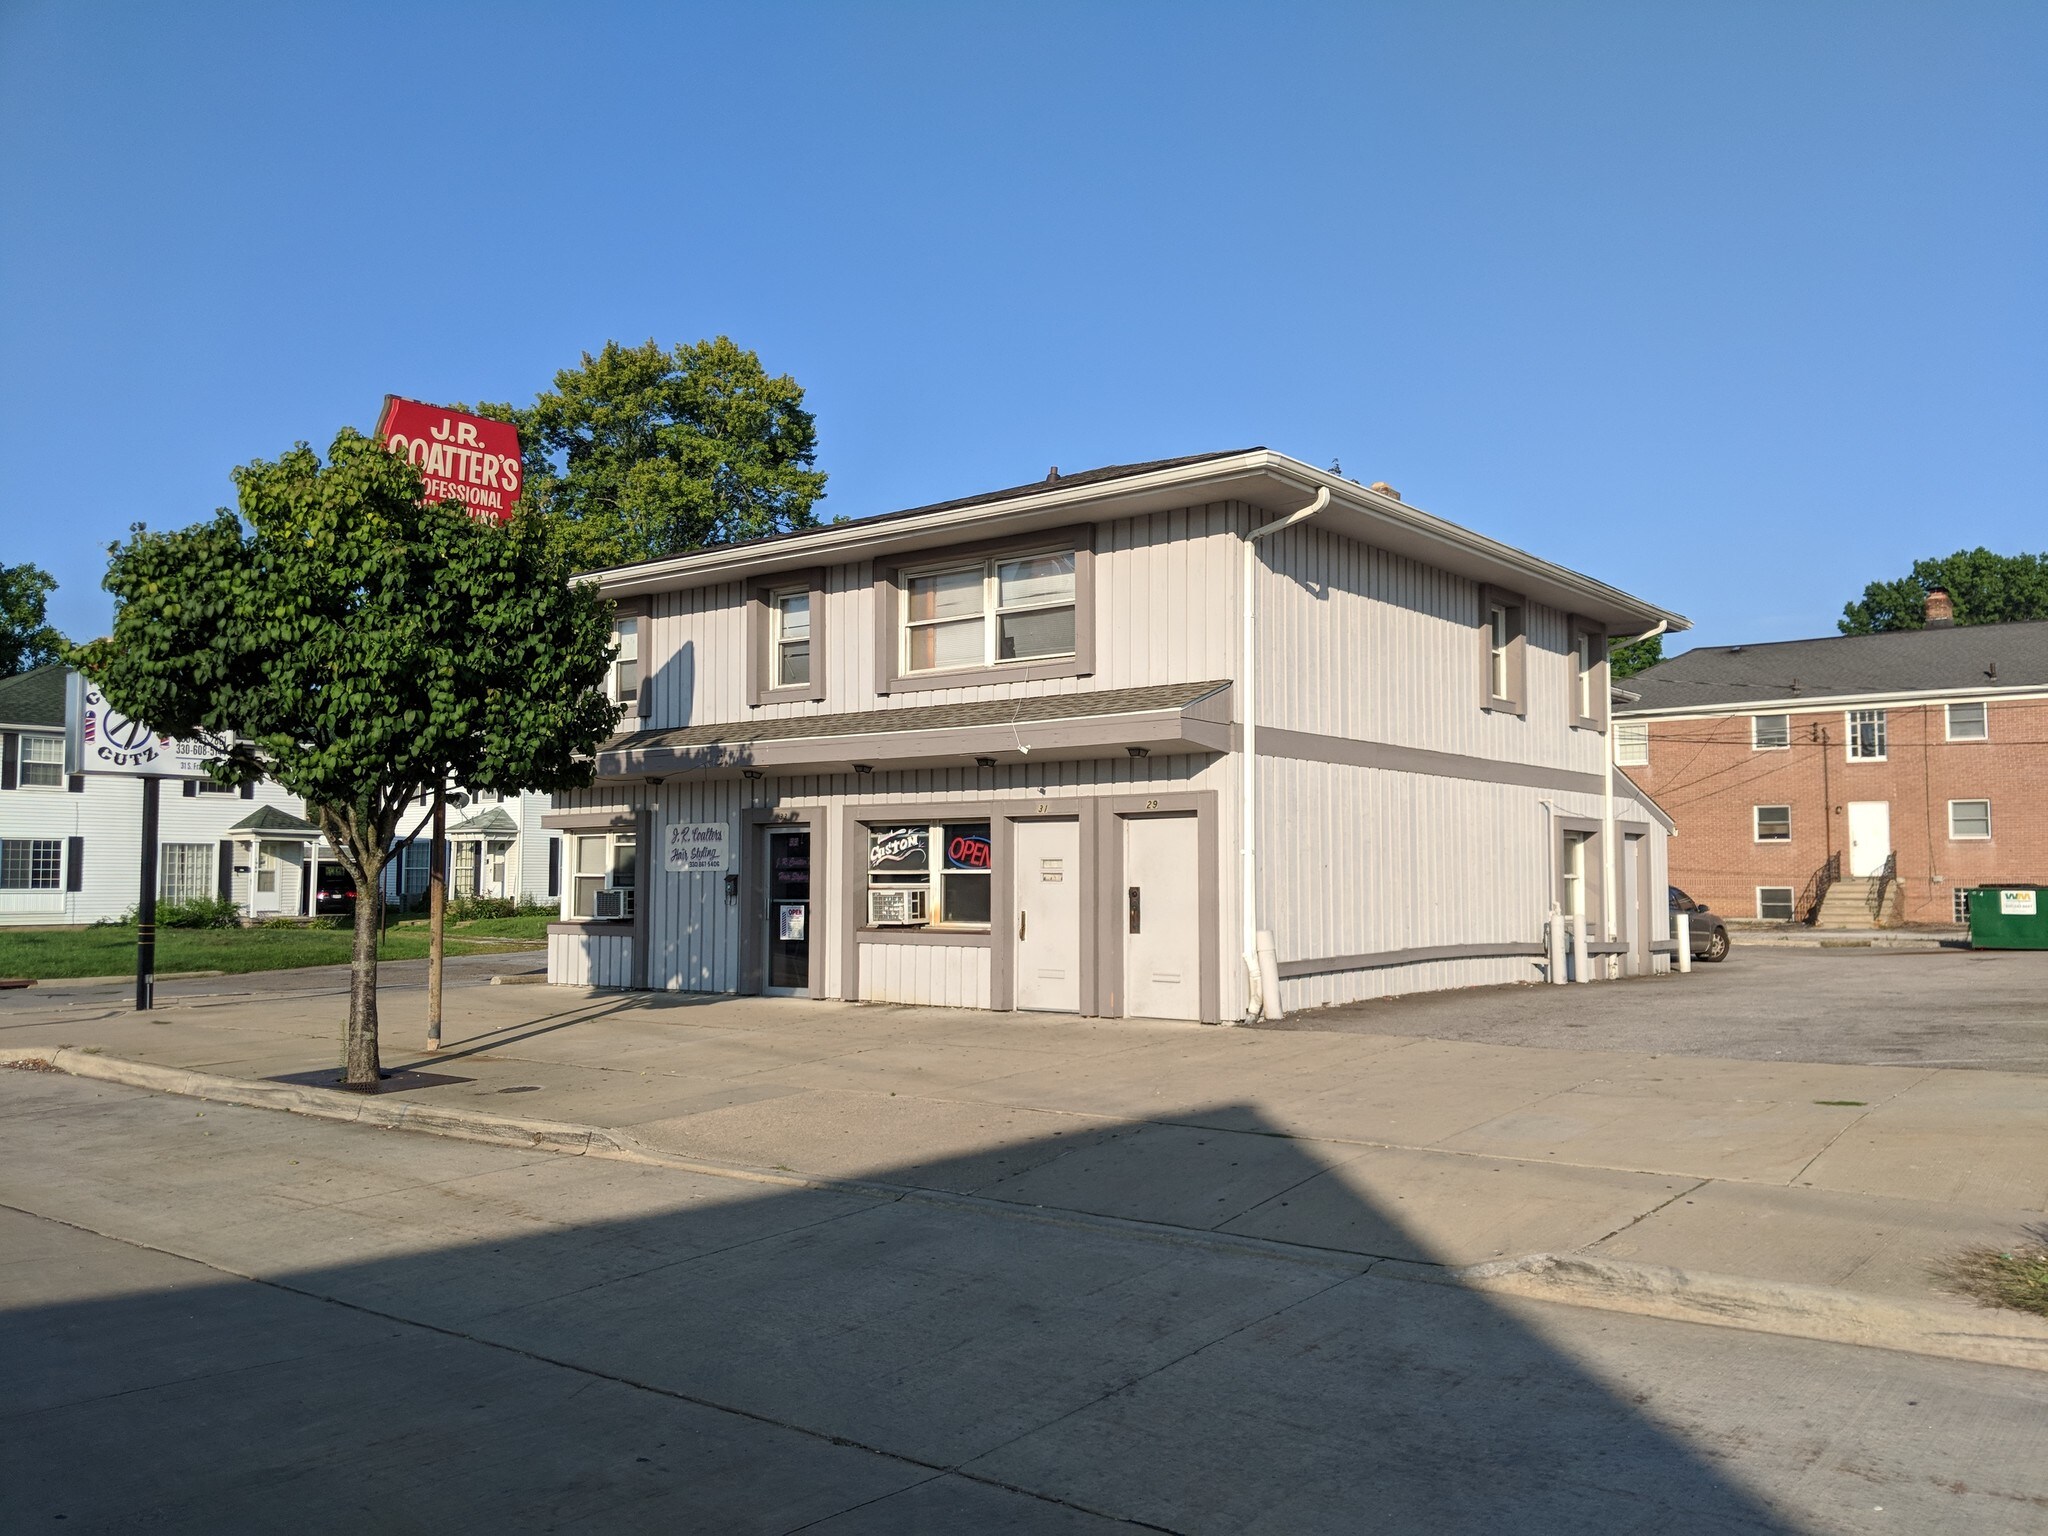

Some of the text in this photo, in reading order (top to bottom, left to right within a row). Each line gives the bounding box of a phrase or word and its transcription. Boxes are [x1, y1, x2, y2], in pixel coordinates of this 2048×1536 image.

[430, 418, 486, 449] J.R.
[421, 477, 504, 510] OFESSIONAL
[97, 746, 159, 766] CUTZ
[1038, 804, 1048, 813] 31
[1146, 800, 1158, 809] 29
[950, 837, 991, 869] OPEN
